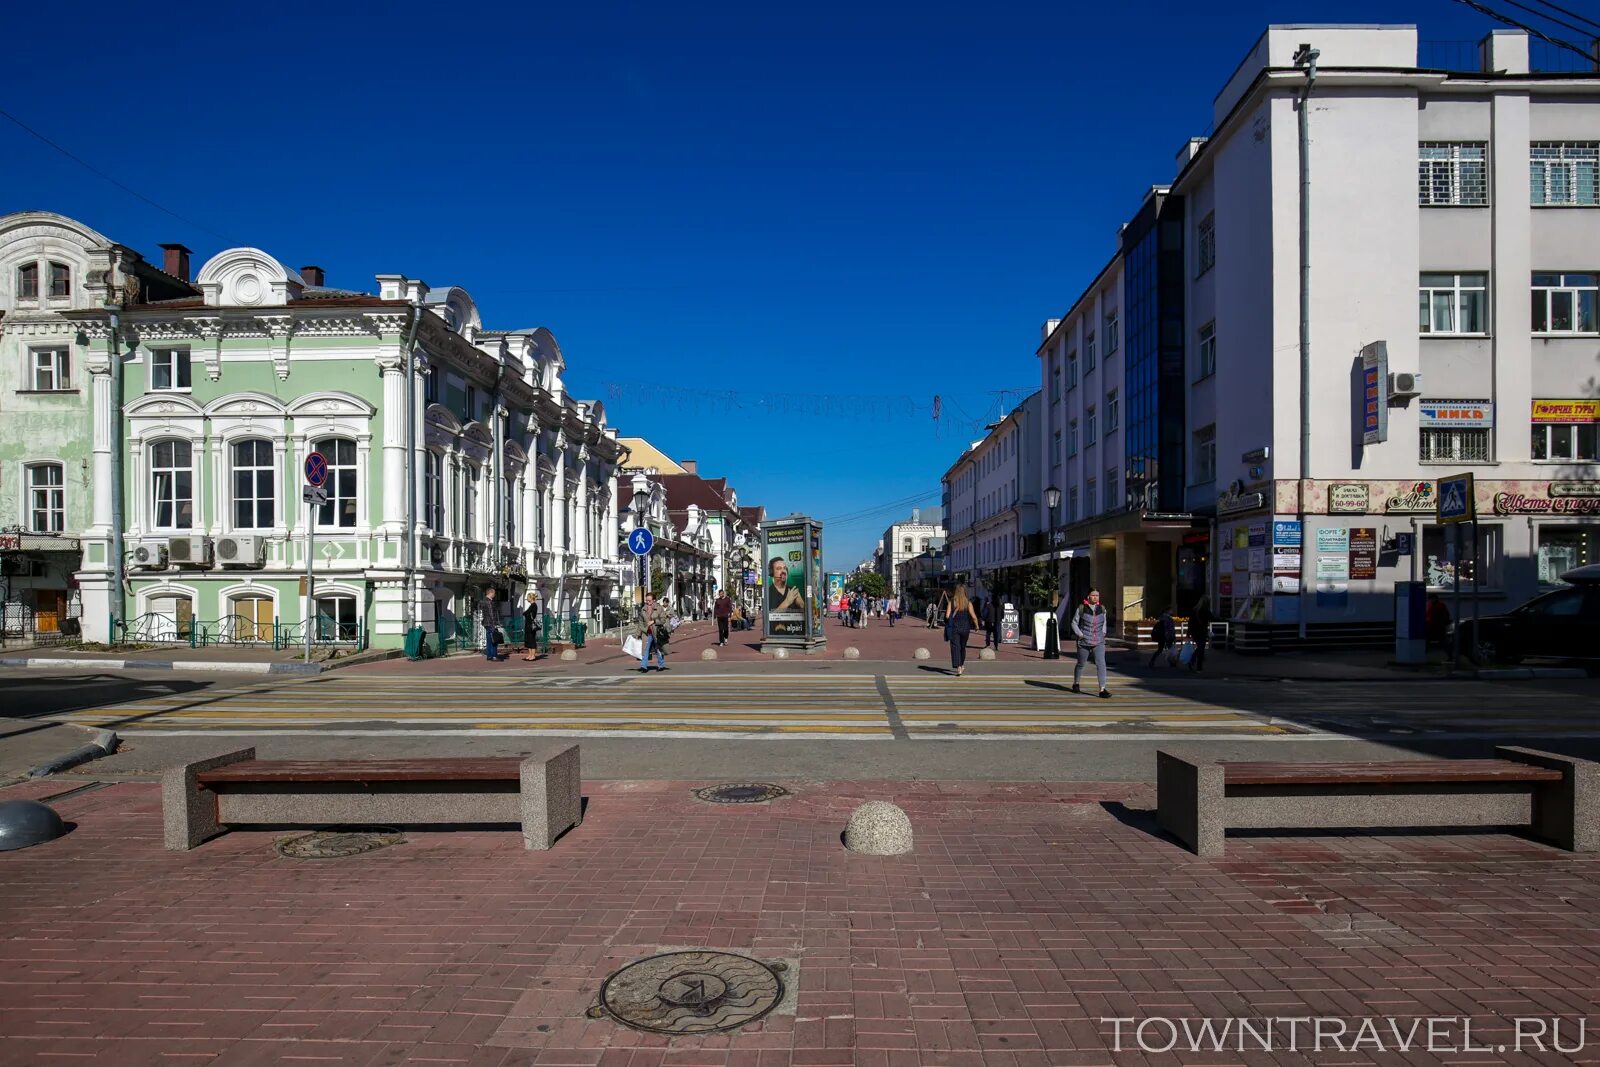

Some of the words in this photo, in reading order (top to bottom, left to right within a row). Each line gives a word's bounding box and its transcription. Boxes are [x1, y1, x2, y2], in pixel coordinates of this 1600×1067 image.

[1535, 404, 1572, 414] ГОРЯЧИЕ
[1574, 404, 1596, 414] ТУРЫ
[1498, 492, 1552, 512] Цветы
[1556, 499, 1564, 508] &
[786, 624, 803, 634] alpari
